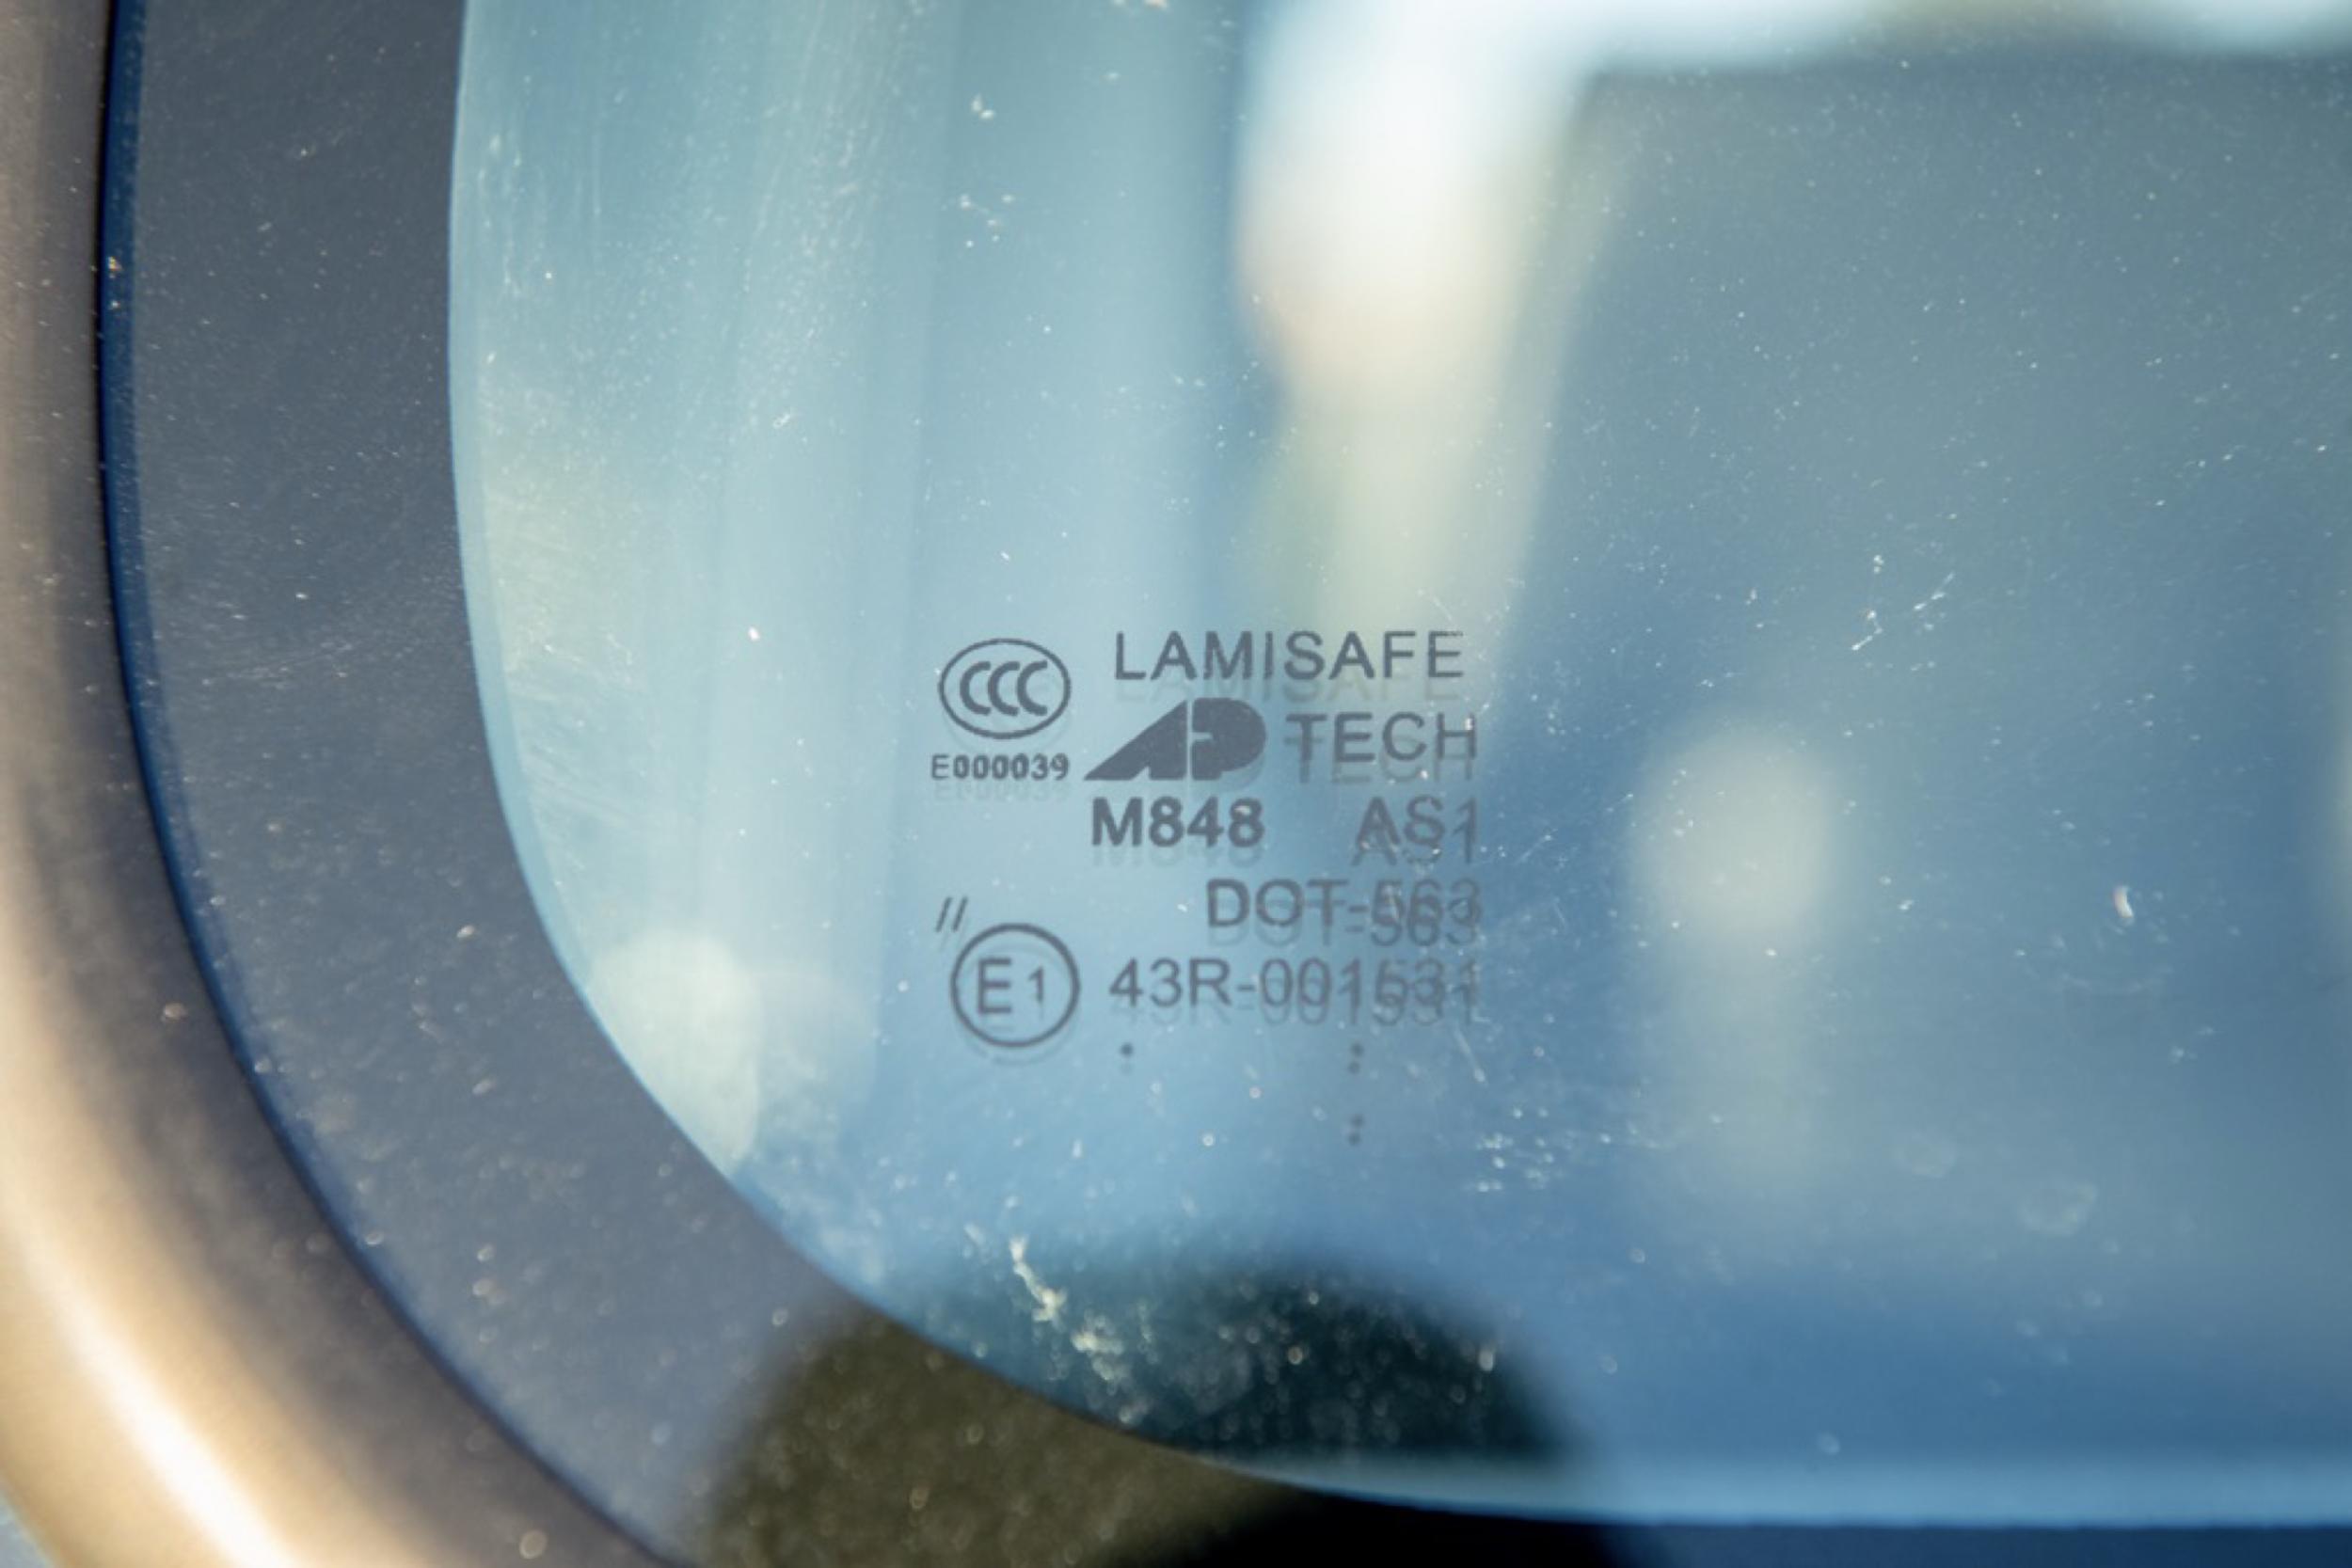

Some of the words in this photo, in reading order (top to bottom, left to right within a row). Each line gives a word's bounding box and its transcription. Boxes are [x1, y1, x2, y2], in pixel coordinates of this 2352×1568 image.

[1115, 630, 1465, 681] LAMISAFE
[959, 660, 1048, 717] CCC
[1284, 712, 1477, 763] TECH
[931, 752, 1069, 781] E000039
[1091, 797, 1264, 847] M848
[1357, 795, 1477, 847] AS1
